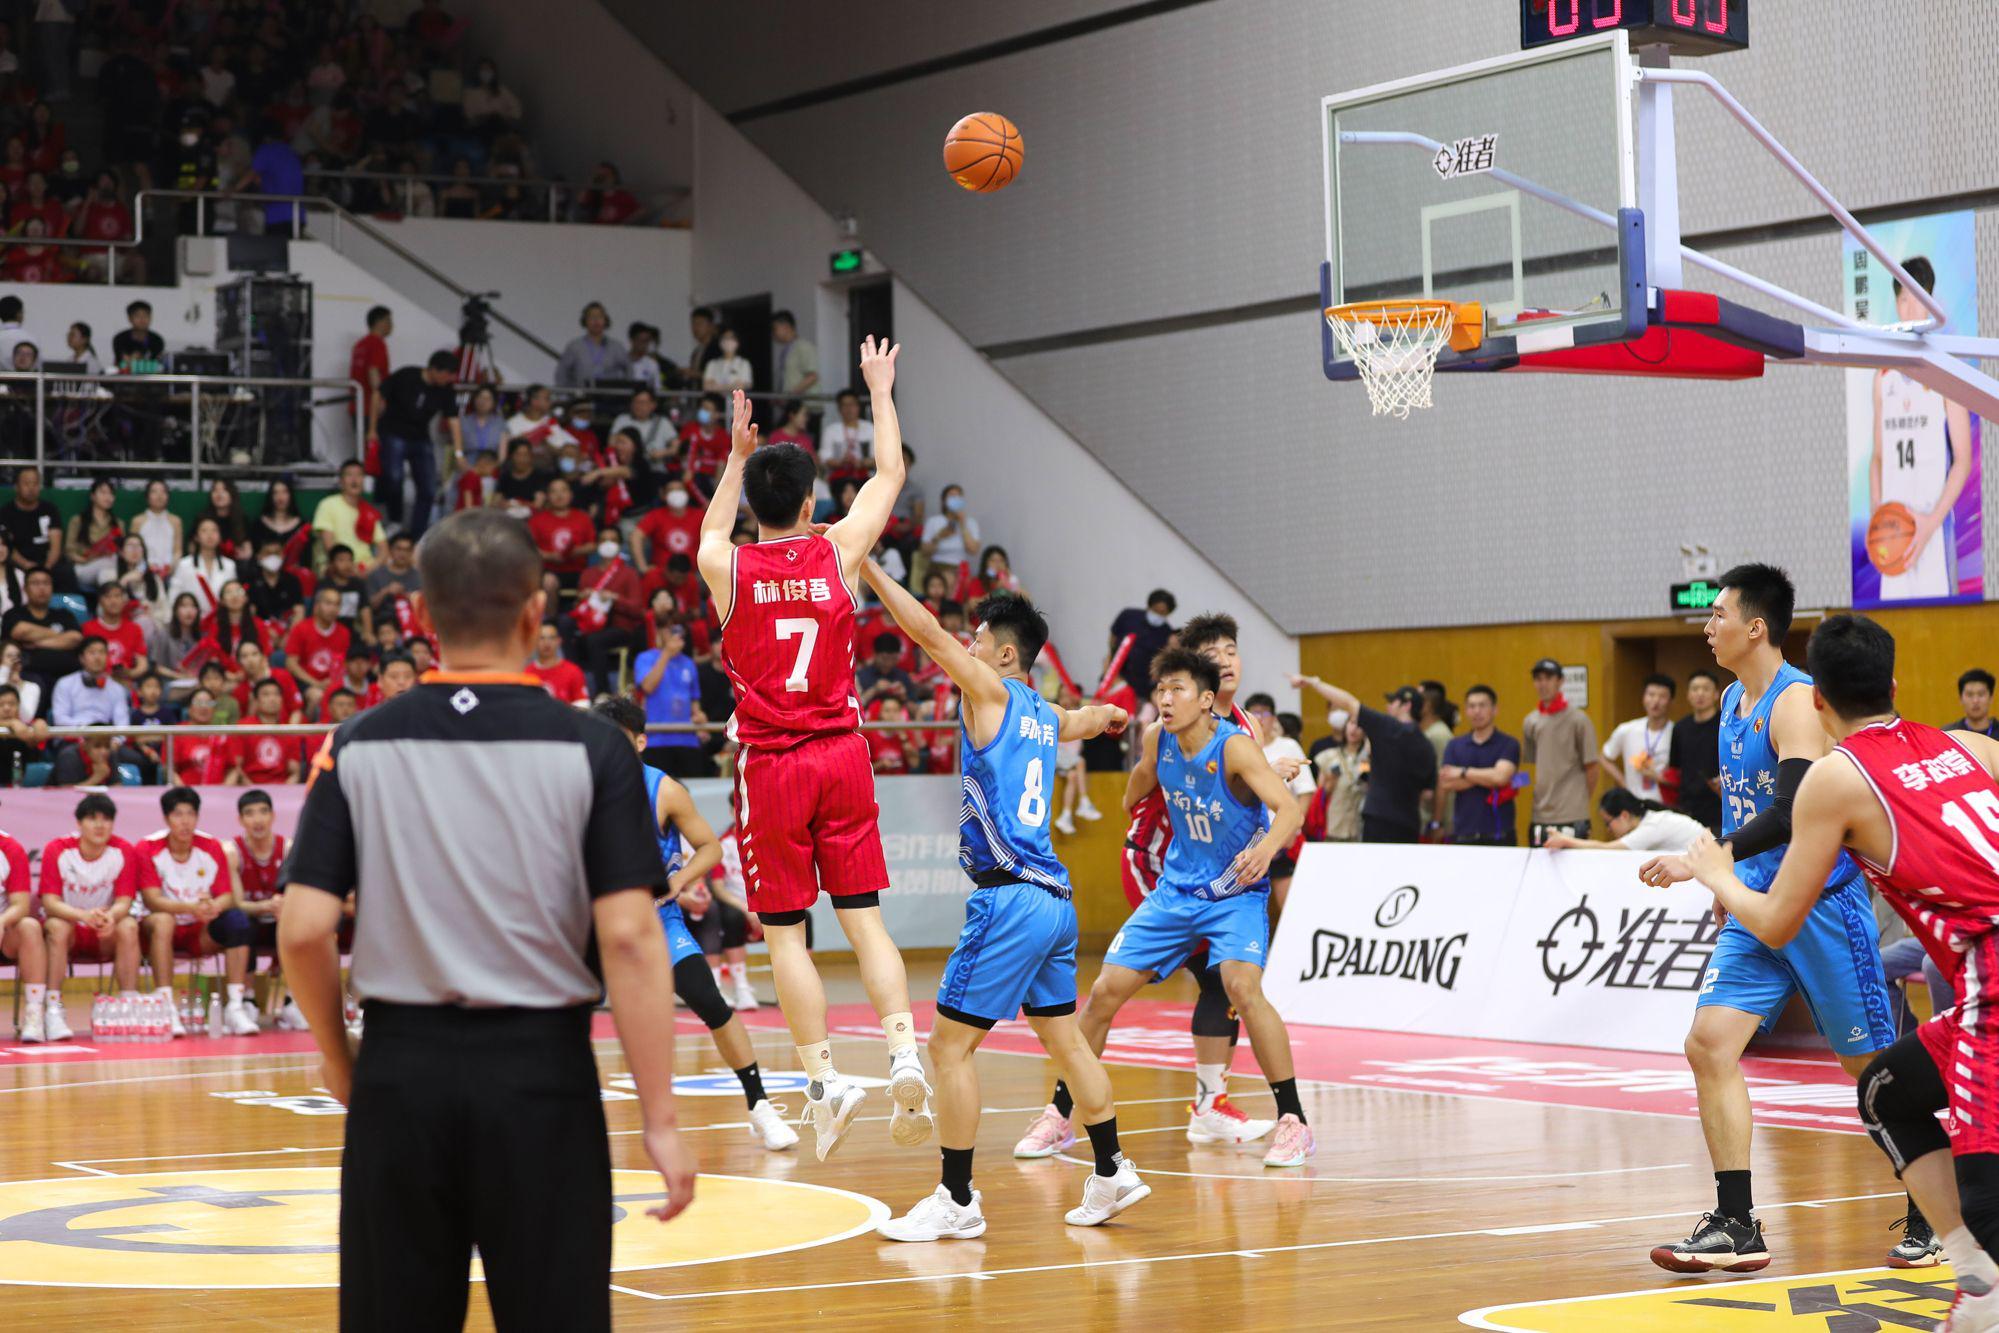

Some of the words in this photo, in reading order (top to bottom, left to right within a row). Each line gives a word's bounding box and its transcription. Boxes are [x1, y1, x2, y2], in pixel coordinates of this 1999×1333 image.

[1453, 137, 1494, 173] 准者
[1896, 437, 1915, 469] 14
[752, 577, 832, 604] 林俊吾
[775, 617, 820, 693] 7
[1019, 716, 1054, 747] 郭芳
[1017, 757, 1046, 827] 8
[1185, 813, 1213, 844] 10
[1728, 795, 1757, 829] 22
[1299, 928, 1469, 991] SPALDING
[1586, 907, 1720, 992] 准者
